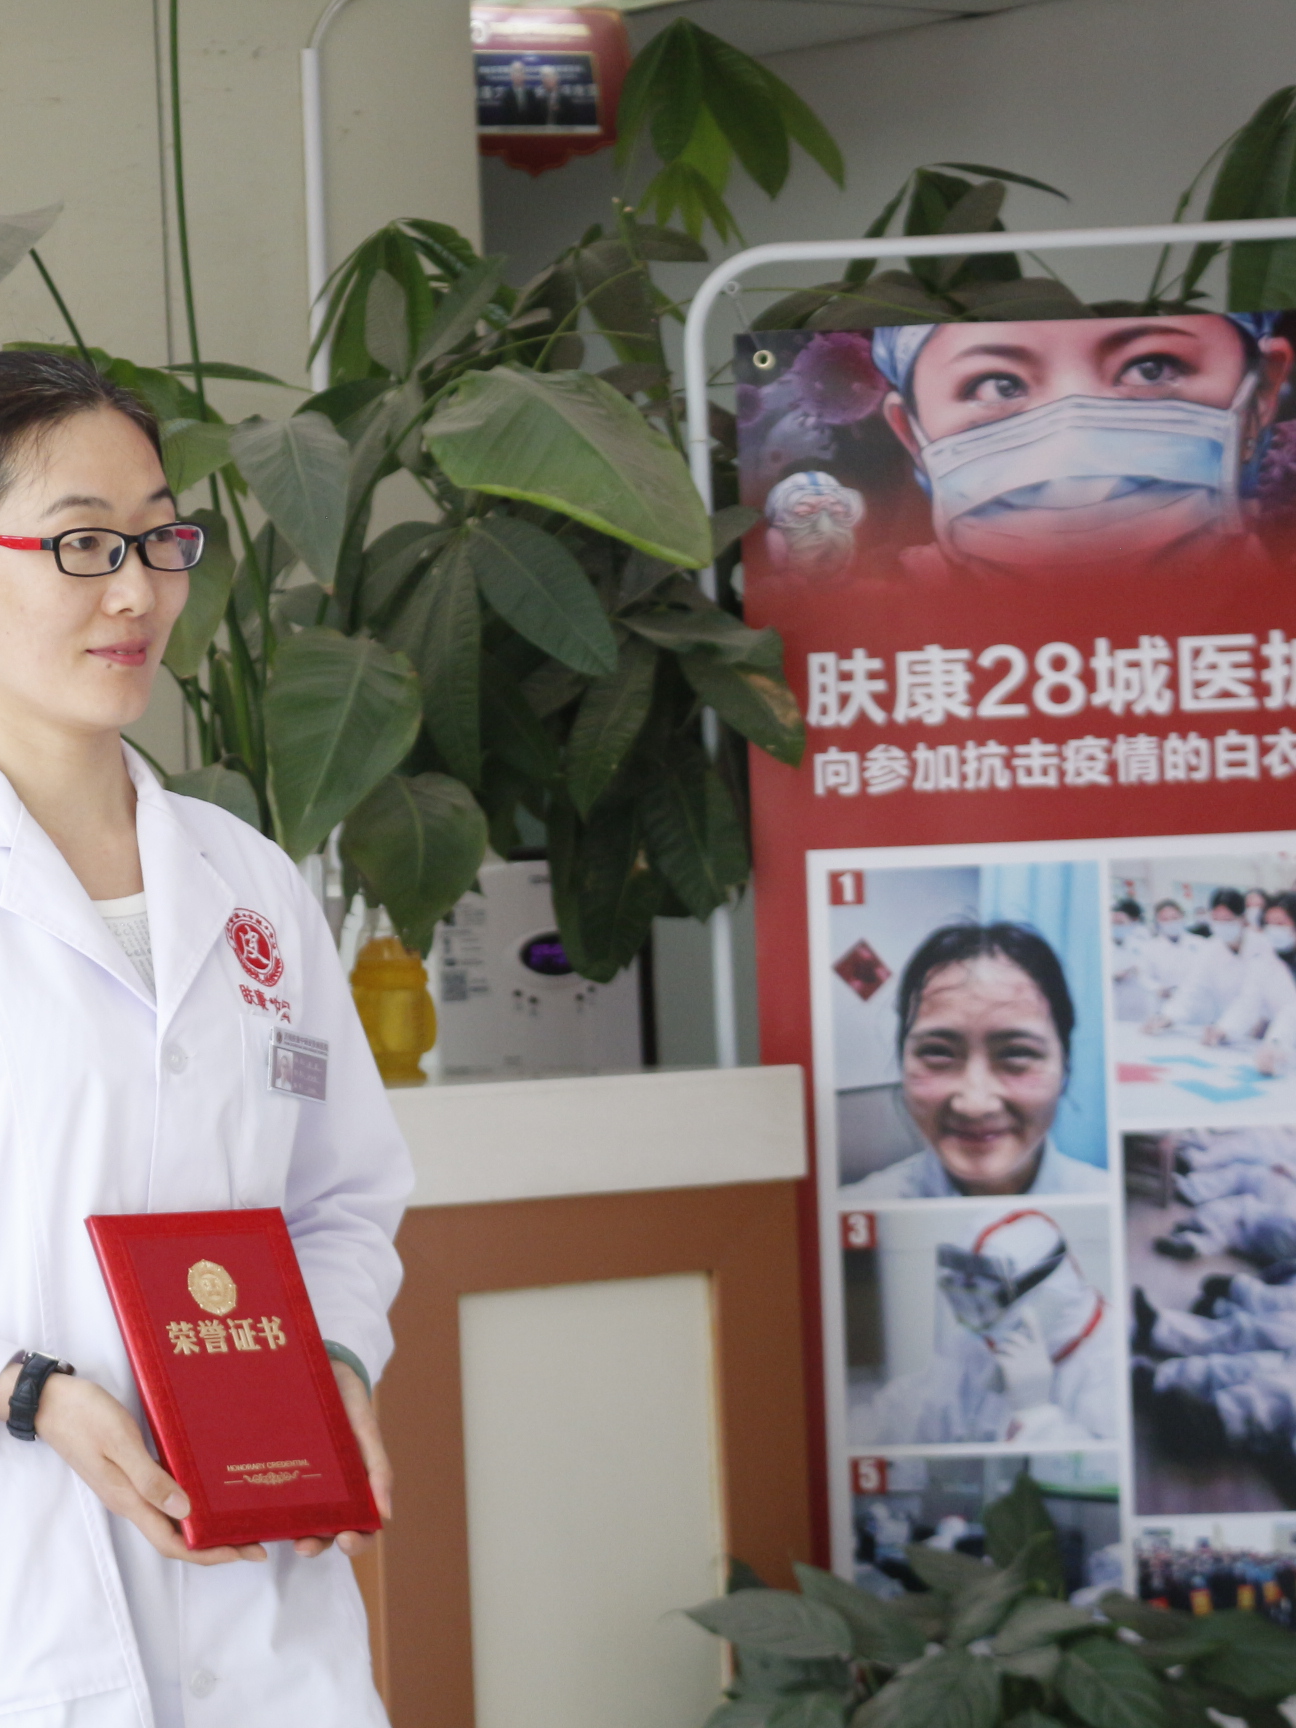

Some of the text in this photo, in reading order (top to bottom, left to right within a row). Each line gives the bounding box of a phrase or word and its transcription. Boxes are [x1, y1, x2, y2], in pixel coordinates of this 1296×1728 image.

[813, 726, 1296, 797] 向参加抗击疫情的白衣
[837, 870, 856, 903] 1
[847, 1212, 869, 1245] 3
[166, 1316, 288, 1356] 荣誉证书
[226, 1462, 265, 1472] HONORARY
[857, 1459, 880, 1490] 5
